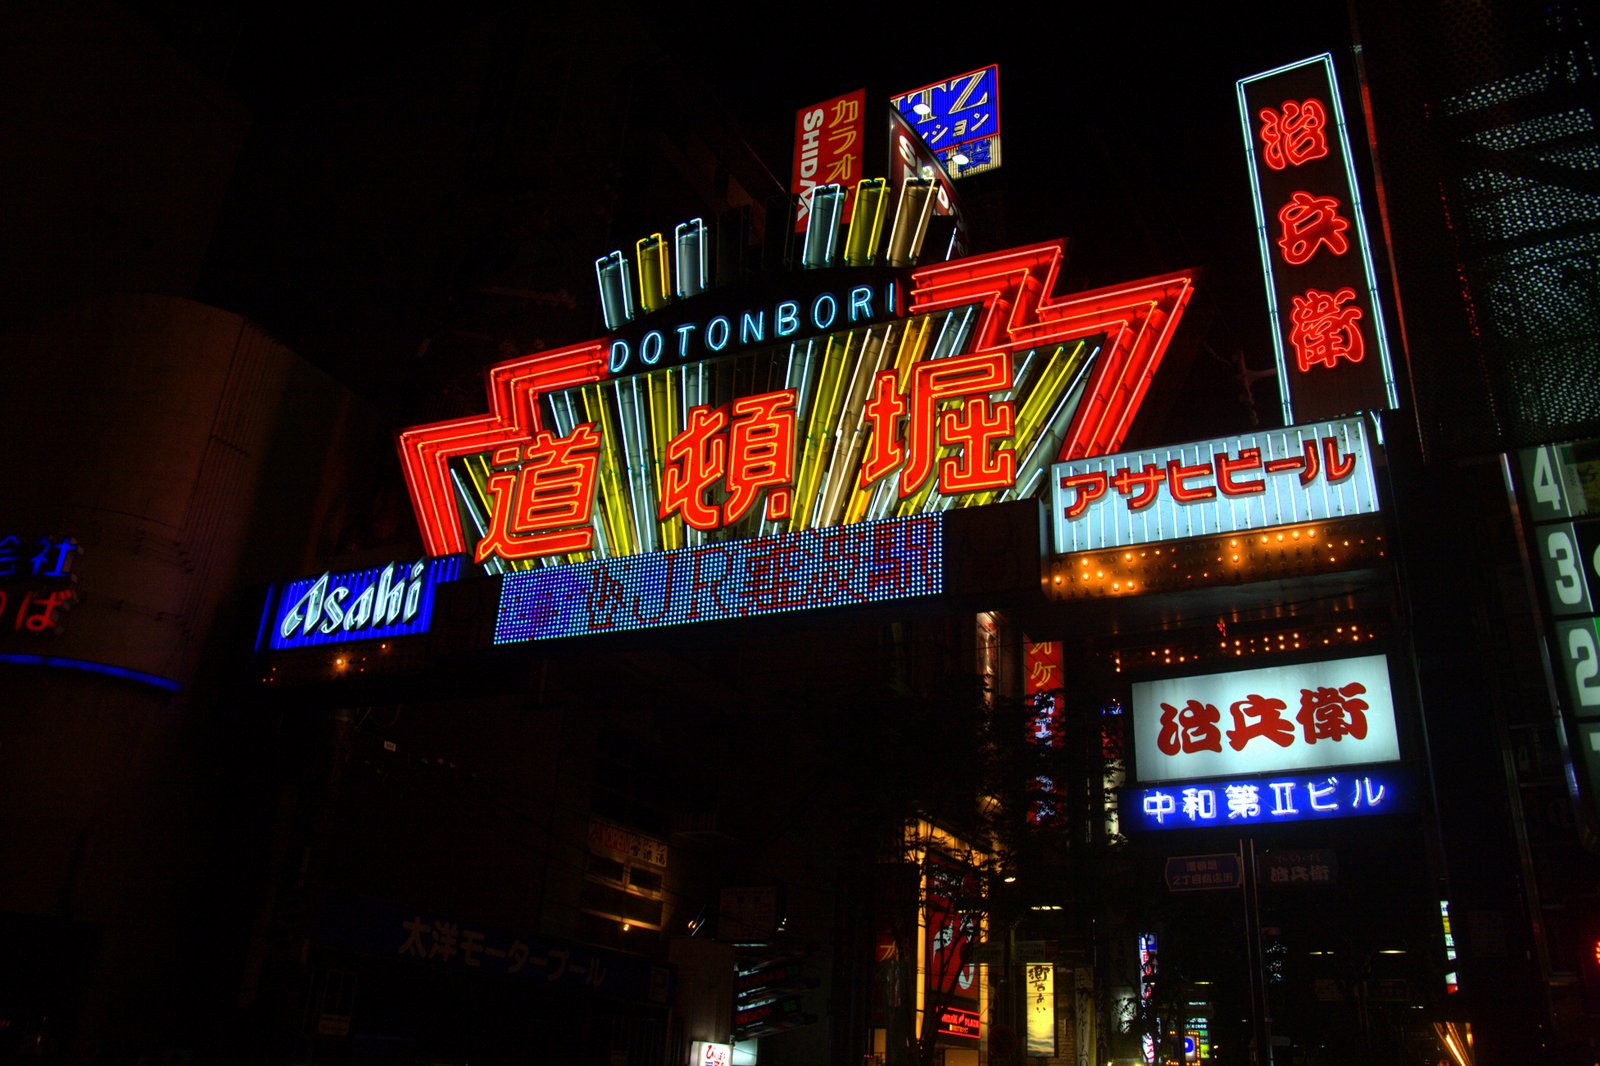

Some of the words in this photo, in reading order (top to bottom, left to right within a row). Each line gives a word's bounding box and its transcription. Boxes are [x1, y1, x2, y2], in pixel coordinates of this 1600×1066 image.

[825, 99, 858, 201] カラオ
[922, 113, 990, 144] ション
[607, 279, 897, 375] DOTONBORI
[474, 348, 1017, 564] 道頓堀
[1060, 436, 1355, 520] アサヒビール
[1533, 446, 1561, 511] 4
[280, 559, 426, 639] Asahi
[1548, 531, 1583, 605] 3
[1568, 628, 1600, 707] 2
[1157, 682, 1369, 757] 治兵衛
